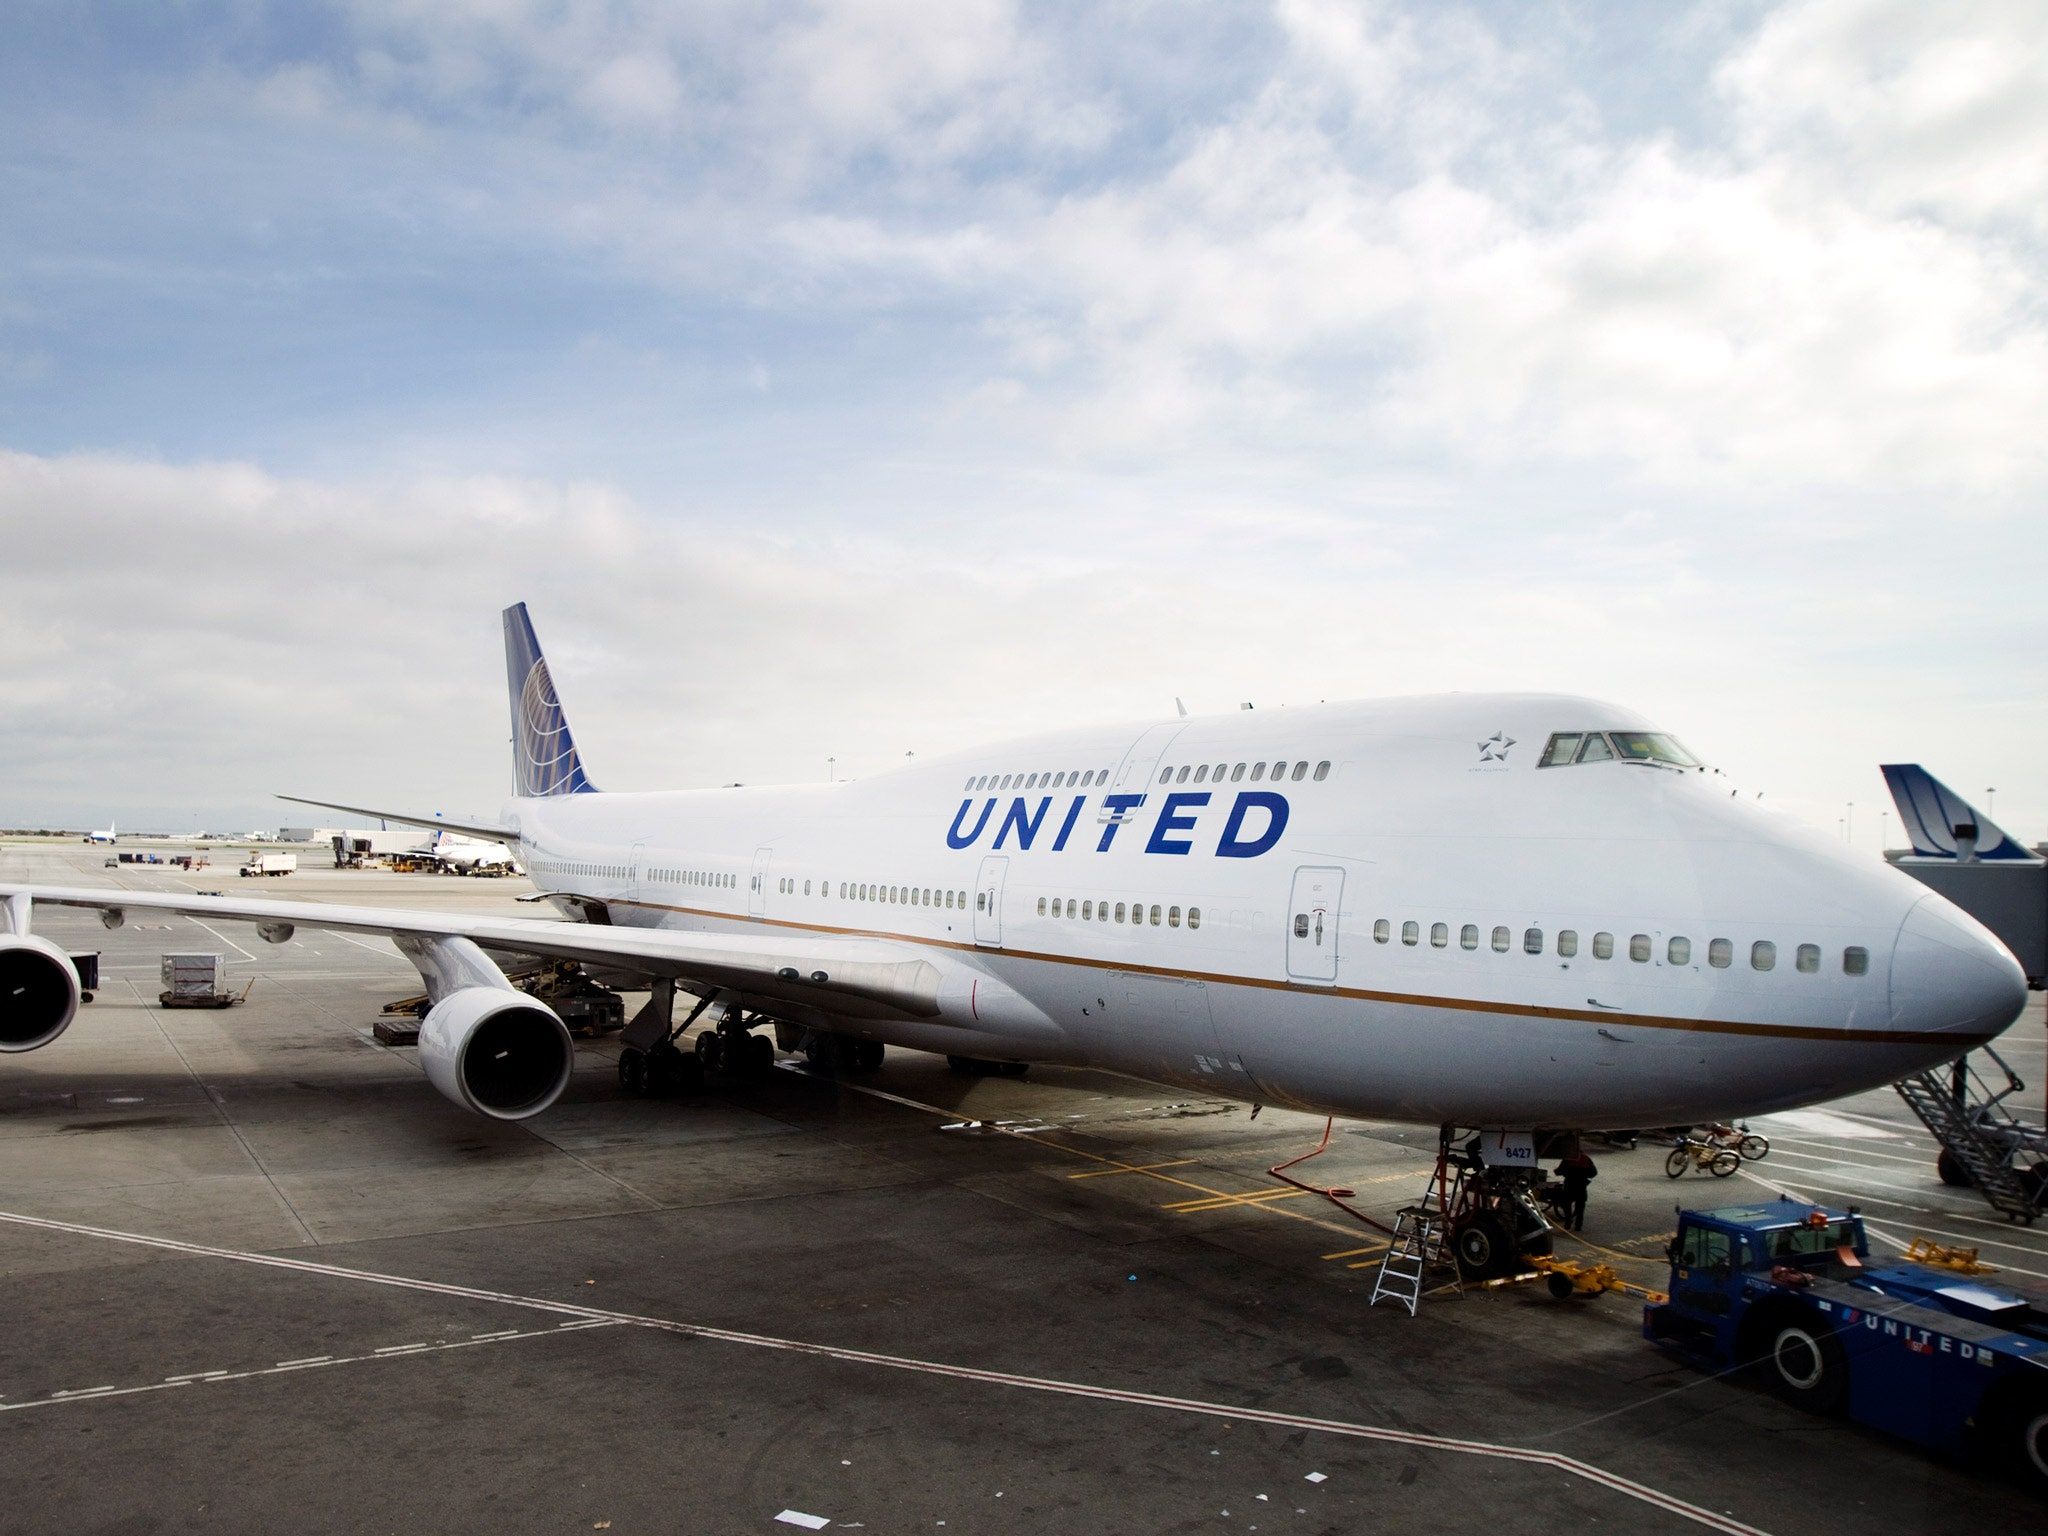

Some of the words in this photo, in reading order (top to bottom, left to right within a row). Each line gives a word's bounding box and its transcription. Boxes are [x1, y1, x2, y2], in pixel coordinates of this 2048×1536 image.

[945, 790, 1290, 858] UNITED
[1505, 1147, 1531, 1159] 8427
[1865, 1314, 1974, 1359] UNITED
